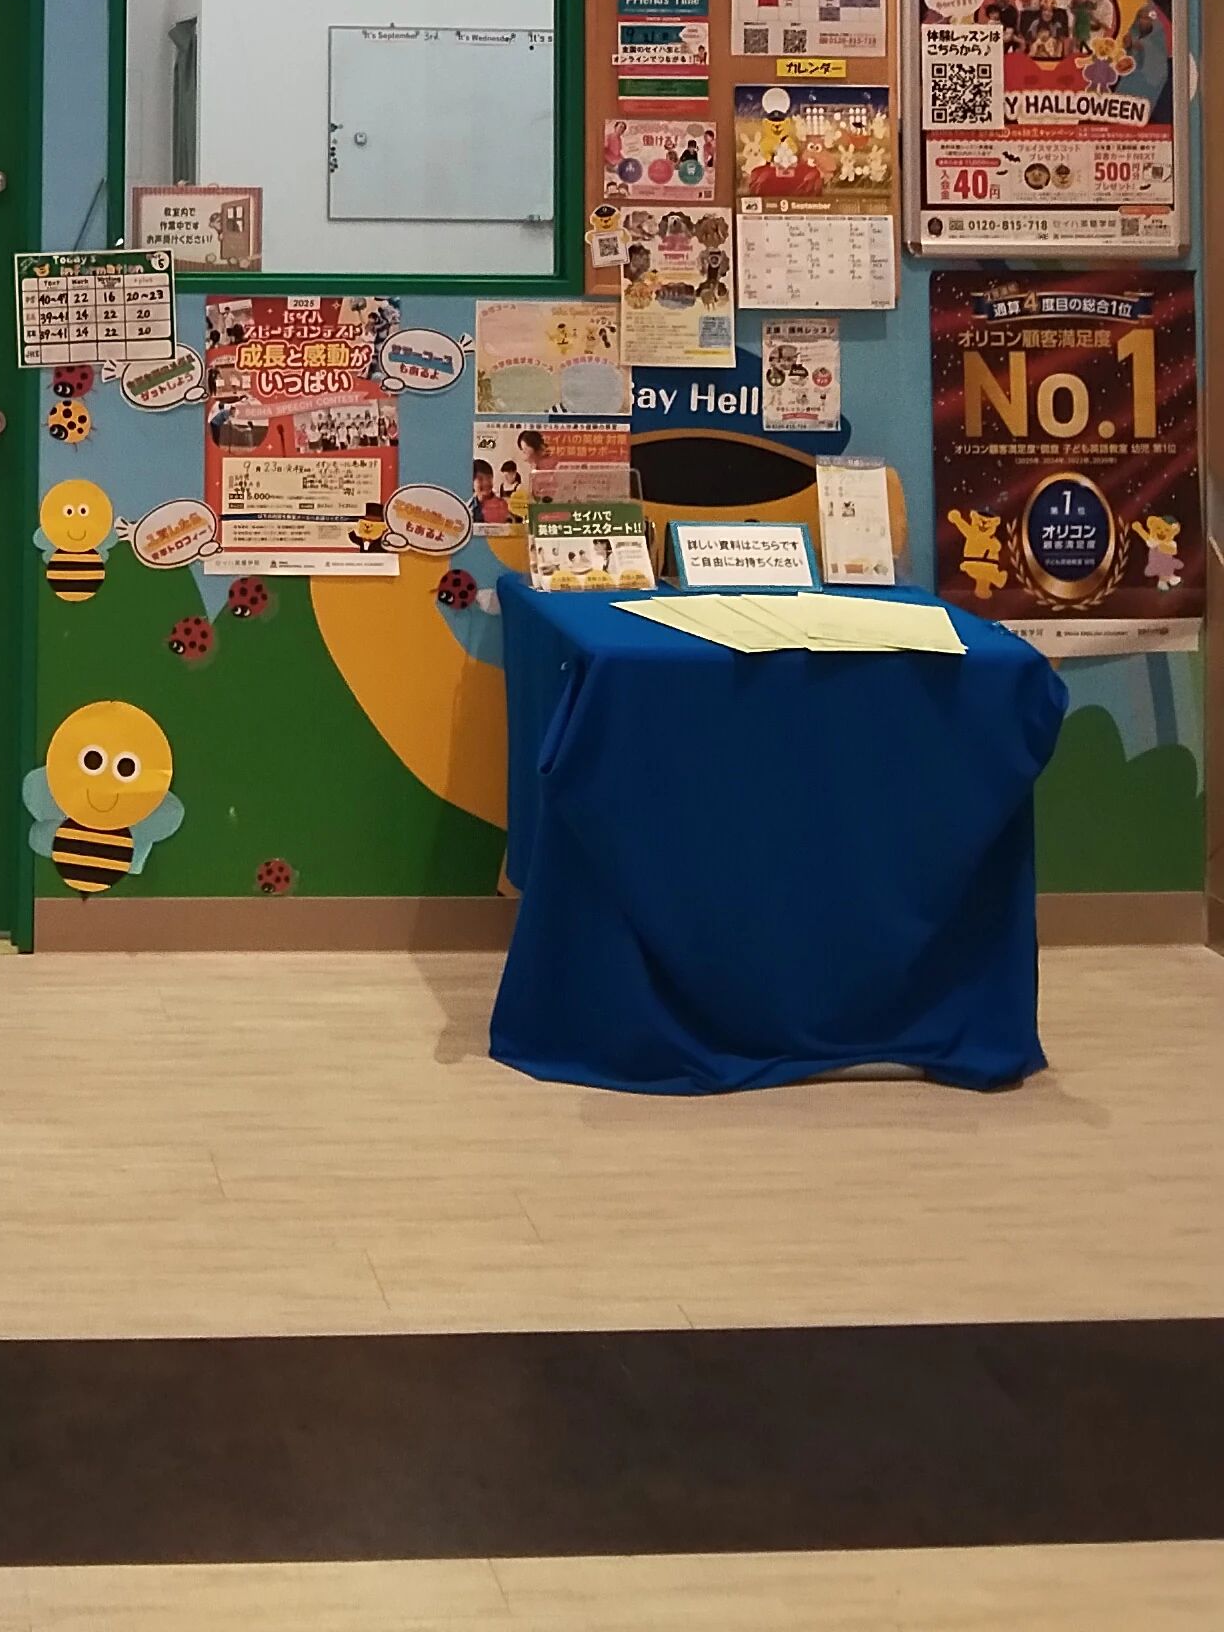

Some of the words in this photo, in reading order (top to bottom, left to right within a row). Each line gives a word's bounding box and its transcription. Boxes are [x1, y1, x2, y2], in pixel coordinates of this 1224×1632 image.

[927, 29, 1001, 43] 体験レッスンは
[786, 61, 843, 74] カレンダー
[1025, 94, 1146, 122] HALLOWEEN
[1094, 162, 1131, 181] 500
[780, 199, 789, 212] 9
[968, 220, 1048, 231] 0120-815-718
[74, 293, 89, 303] 22
[103, 292, 116, 303] 16
[136, 309, 151, 319] 20
[138, 327, 152, 336] 20
[958, 329, 1112, 349] オリコン顧客満足度
[239, 343, 370, 368] 成長と感動が
[260, 370, 349, 393] いっぱい
[963, 329, 1157, 439] No.1
[631, 382, 677, 415] ay
[690, 383, 759, 415] Hell
[572, 510, 612, 522] セイハで
[1042, 525, 1097, 540] オリコン
[687, 539, 799, 551] 詳しい資料はこちらです
[691, 556, 803, 568] ご自由にお持ちください
